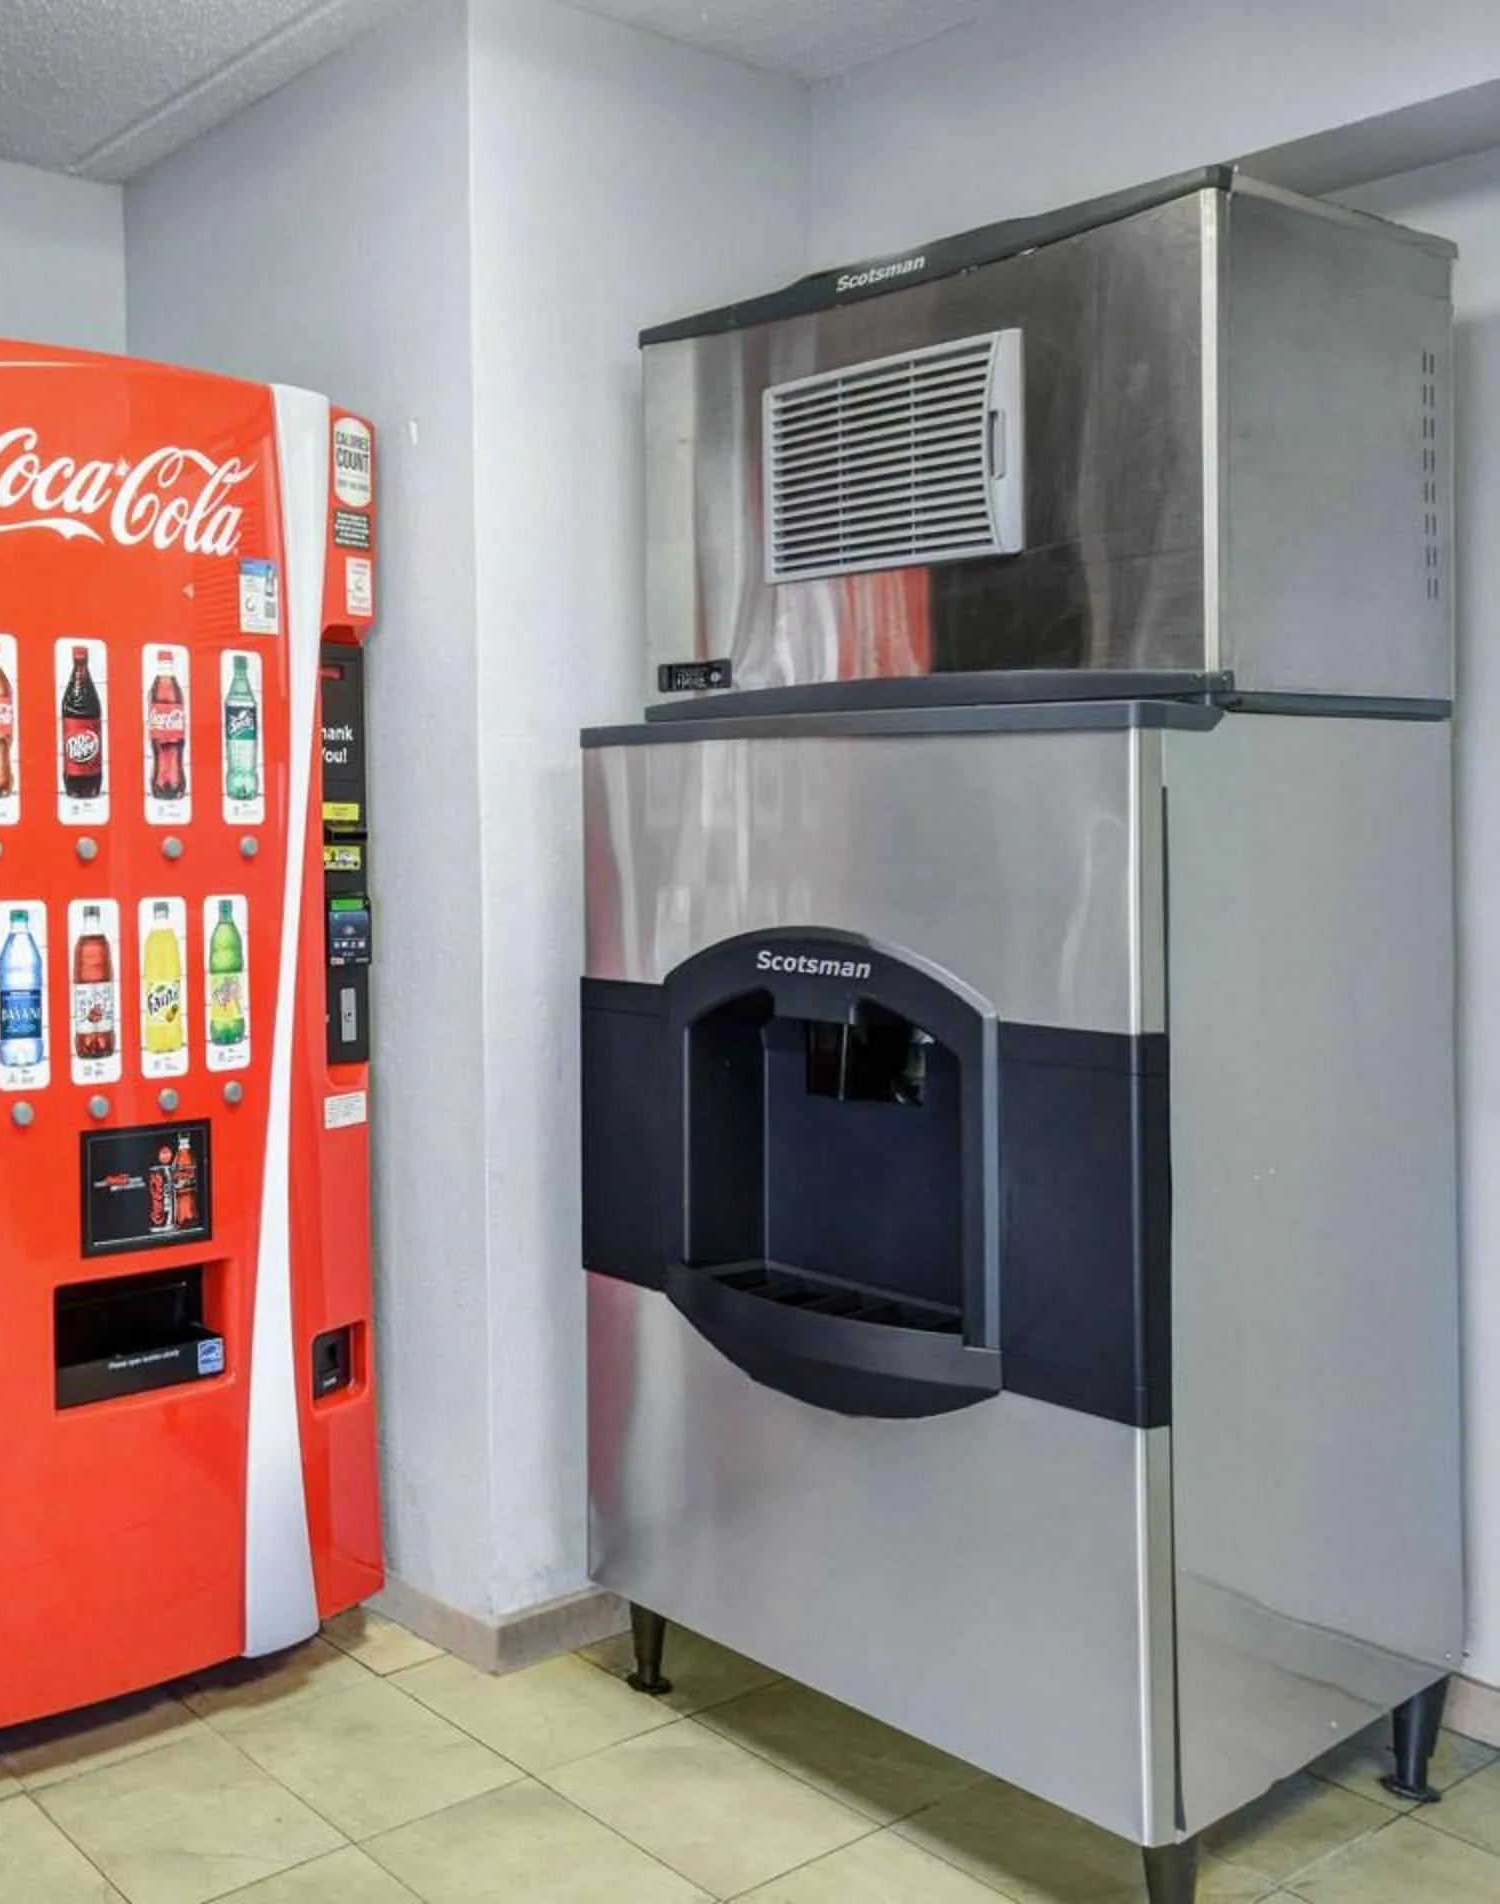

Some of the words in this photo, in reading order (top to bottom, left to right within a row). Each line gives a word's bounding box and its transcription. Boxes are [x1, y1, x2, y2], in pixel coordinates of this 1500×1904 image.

[836, 256, 926, 293] Scotsman
[336, 447, 369, 473] COUNT
[756, 950, 871, 979] Scotsman
